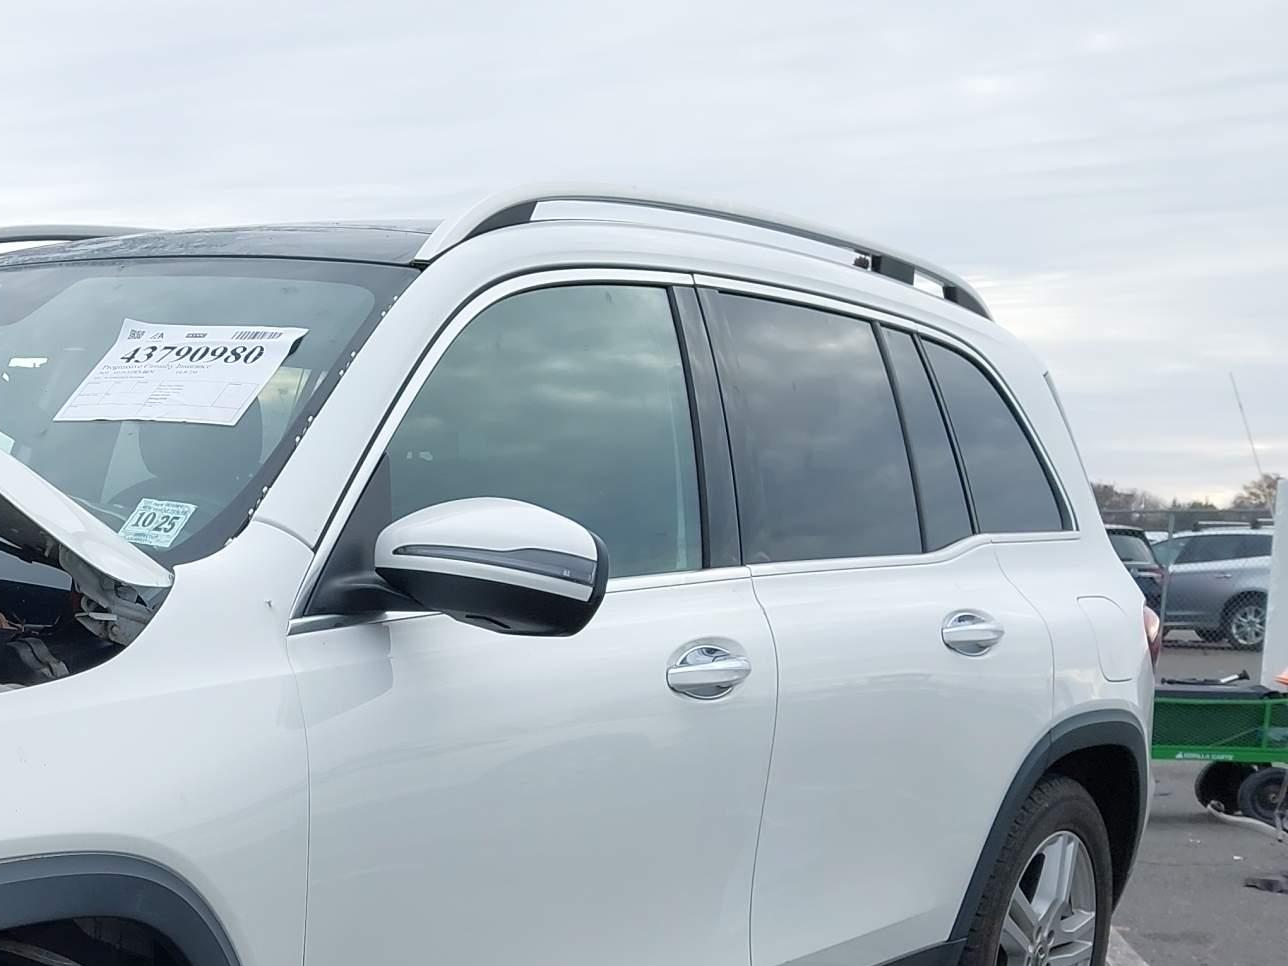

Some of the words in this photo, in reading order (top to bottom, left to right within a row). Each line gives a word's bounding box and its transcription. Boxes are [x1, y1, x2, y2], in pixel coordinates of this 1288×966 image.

[120, 344, 265, 364] 43790980
[132, 511, 157, 528] 10
[152, 515, 180, 533] 25
